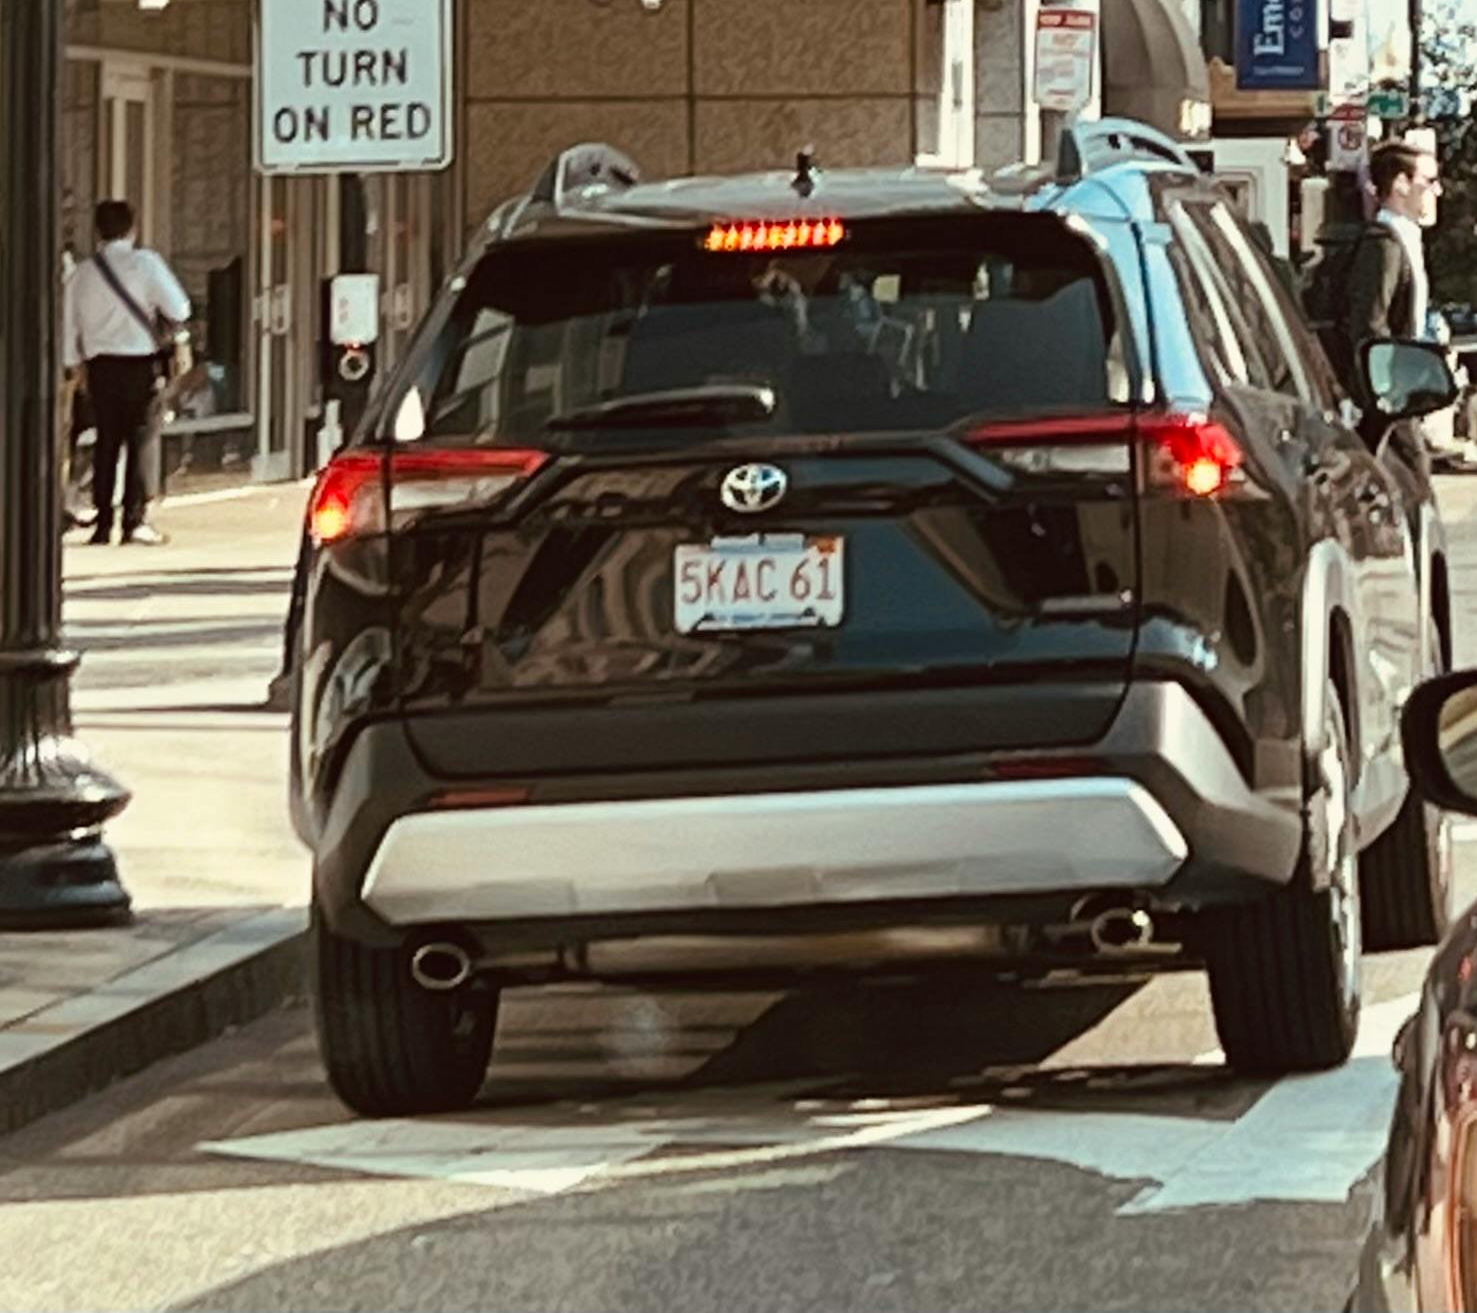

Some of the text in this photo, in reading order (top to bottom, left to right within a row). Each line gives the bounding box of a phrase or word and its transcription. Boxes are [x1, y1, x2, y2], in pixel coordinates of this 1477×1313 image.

[297, 48, 408, 86] TURN
[273, 102, 431, 143] ON RED
[681, 557, 835, 606] 5KAC 61
